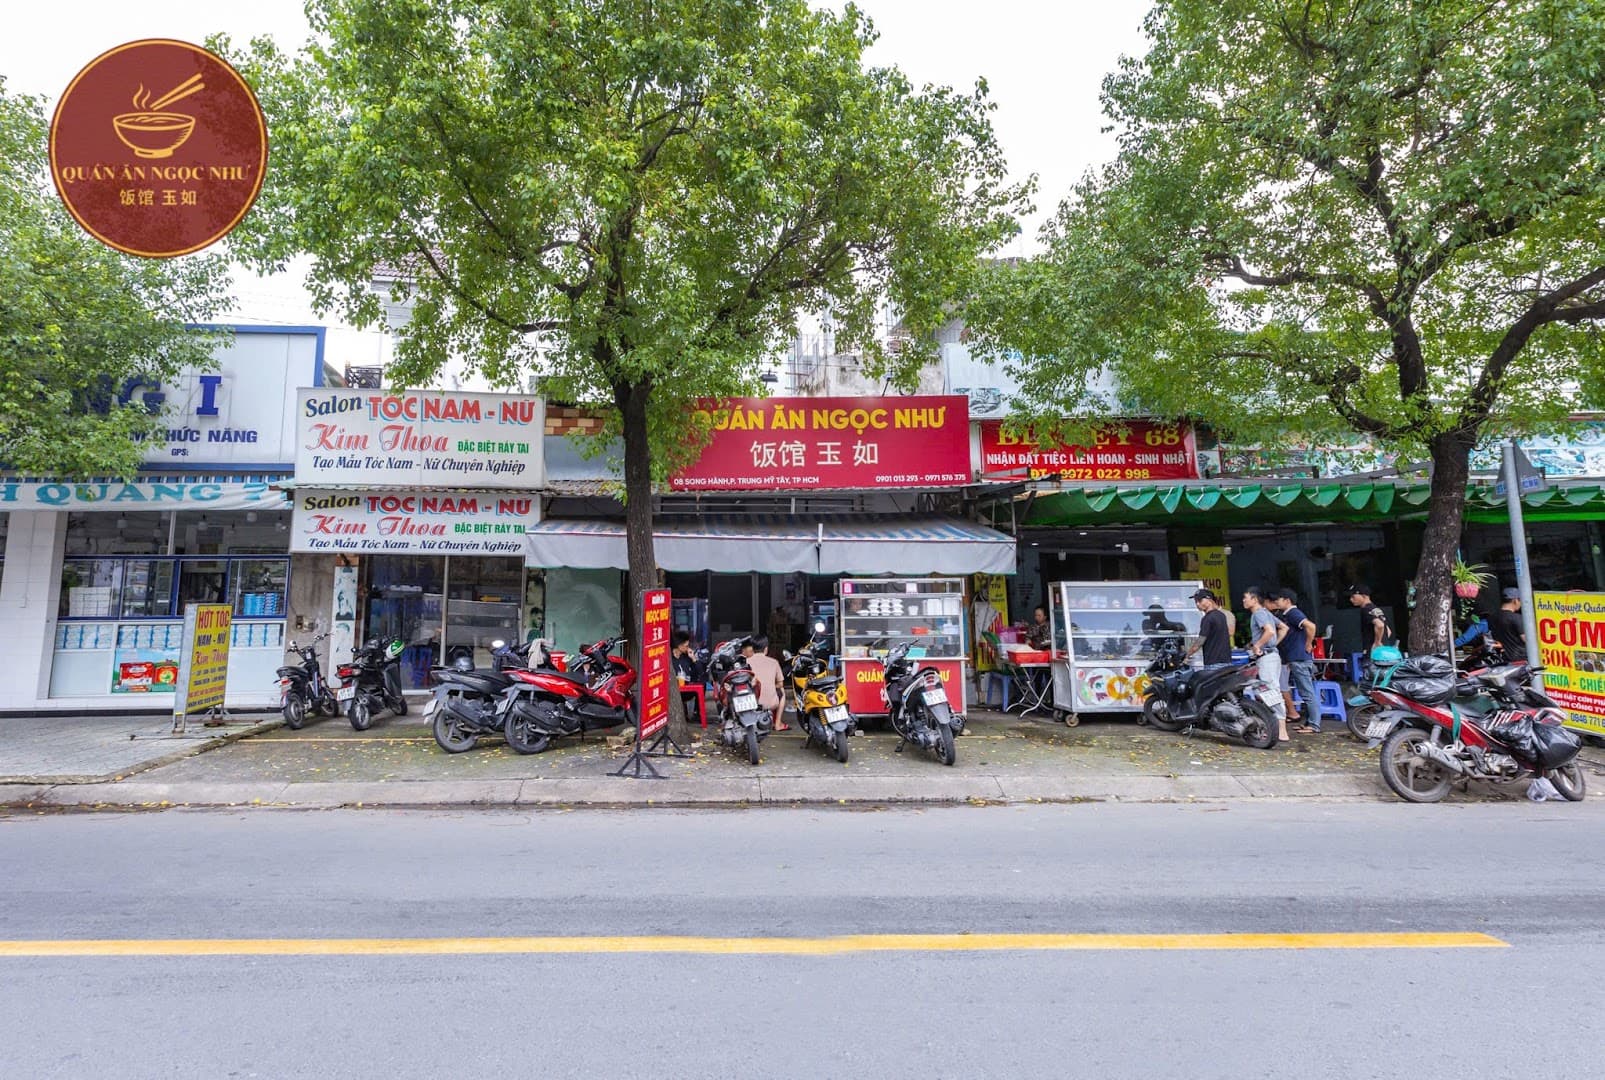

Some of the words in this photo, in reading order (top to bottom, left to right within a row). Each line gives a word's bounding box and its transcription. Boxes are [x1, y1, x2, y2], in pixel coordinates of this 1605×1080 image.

[306, 395, 363, 418] Salon
[421, 398, 481, 423] NAM
[771, 404, 805, 429] ĂN
[812, 408, 888, 435] NGỌC
[894, 405, 946, 429] NHƯ
[208, 427, 258, 443] NĂNG
[305, 423, 370, 451] Kim
[379, 424, 450, 452] Thoa
[1145, 428, 1181, 446] 68
[477, 441, 497, 455] BIỆT
[517, 443, 529, 454] TAI
[750, 440, 806, 468] 饭馆
[816, 442, 842, 466] 玉
[852, 440, 879, 466] 如
[313, 455, 334, 471] Tạo
[365, 456, 386, 469] Tóc
[386, 457, 413, 470] Nam
[441, 458, 483, 473] Chuyên
[485, 460, 526, 475] Nghiệp
[987, 451, 1015, 466] NHẬN
[1018, 451, 1040, 467] ĐẶT
[1044, 451, 1067, 467] TIỆC
[1097, 453, 1125, 465] HOAN
[1135, 453, 1159, 465] SINH
[1162, 451, 1192, 466] NHẬT
[738, 477, 762, 485] TRUNG
[1096, 469, 1121, 479] 022
[36, 484, 224, 505] QUANG
[304, 495, 361, 511] Salon
[419, 497, 478, 515] NAM
[304, 515, 367, 535] Kim
[377, 516, 447, 536] Thoa
[513, 525, 526, 534] TAI
[308, 538, 330, 551] Tạo
[360, 539, 380, 550] Tóc
[381, 540, 409, 551] Nam
[481, 541, 522, 553] Nghiệp
[1539, 617, 1605, 649] CƠM
[1542, 648, 1572, 668] 30K
[857, 670, 885, 684] QUÁN
